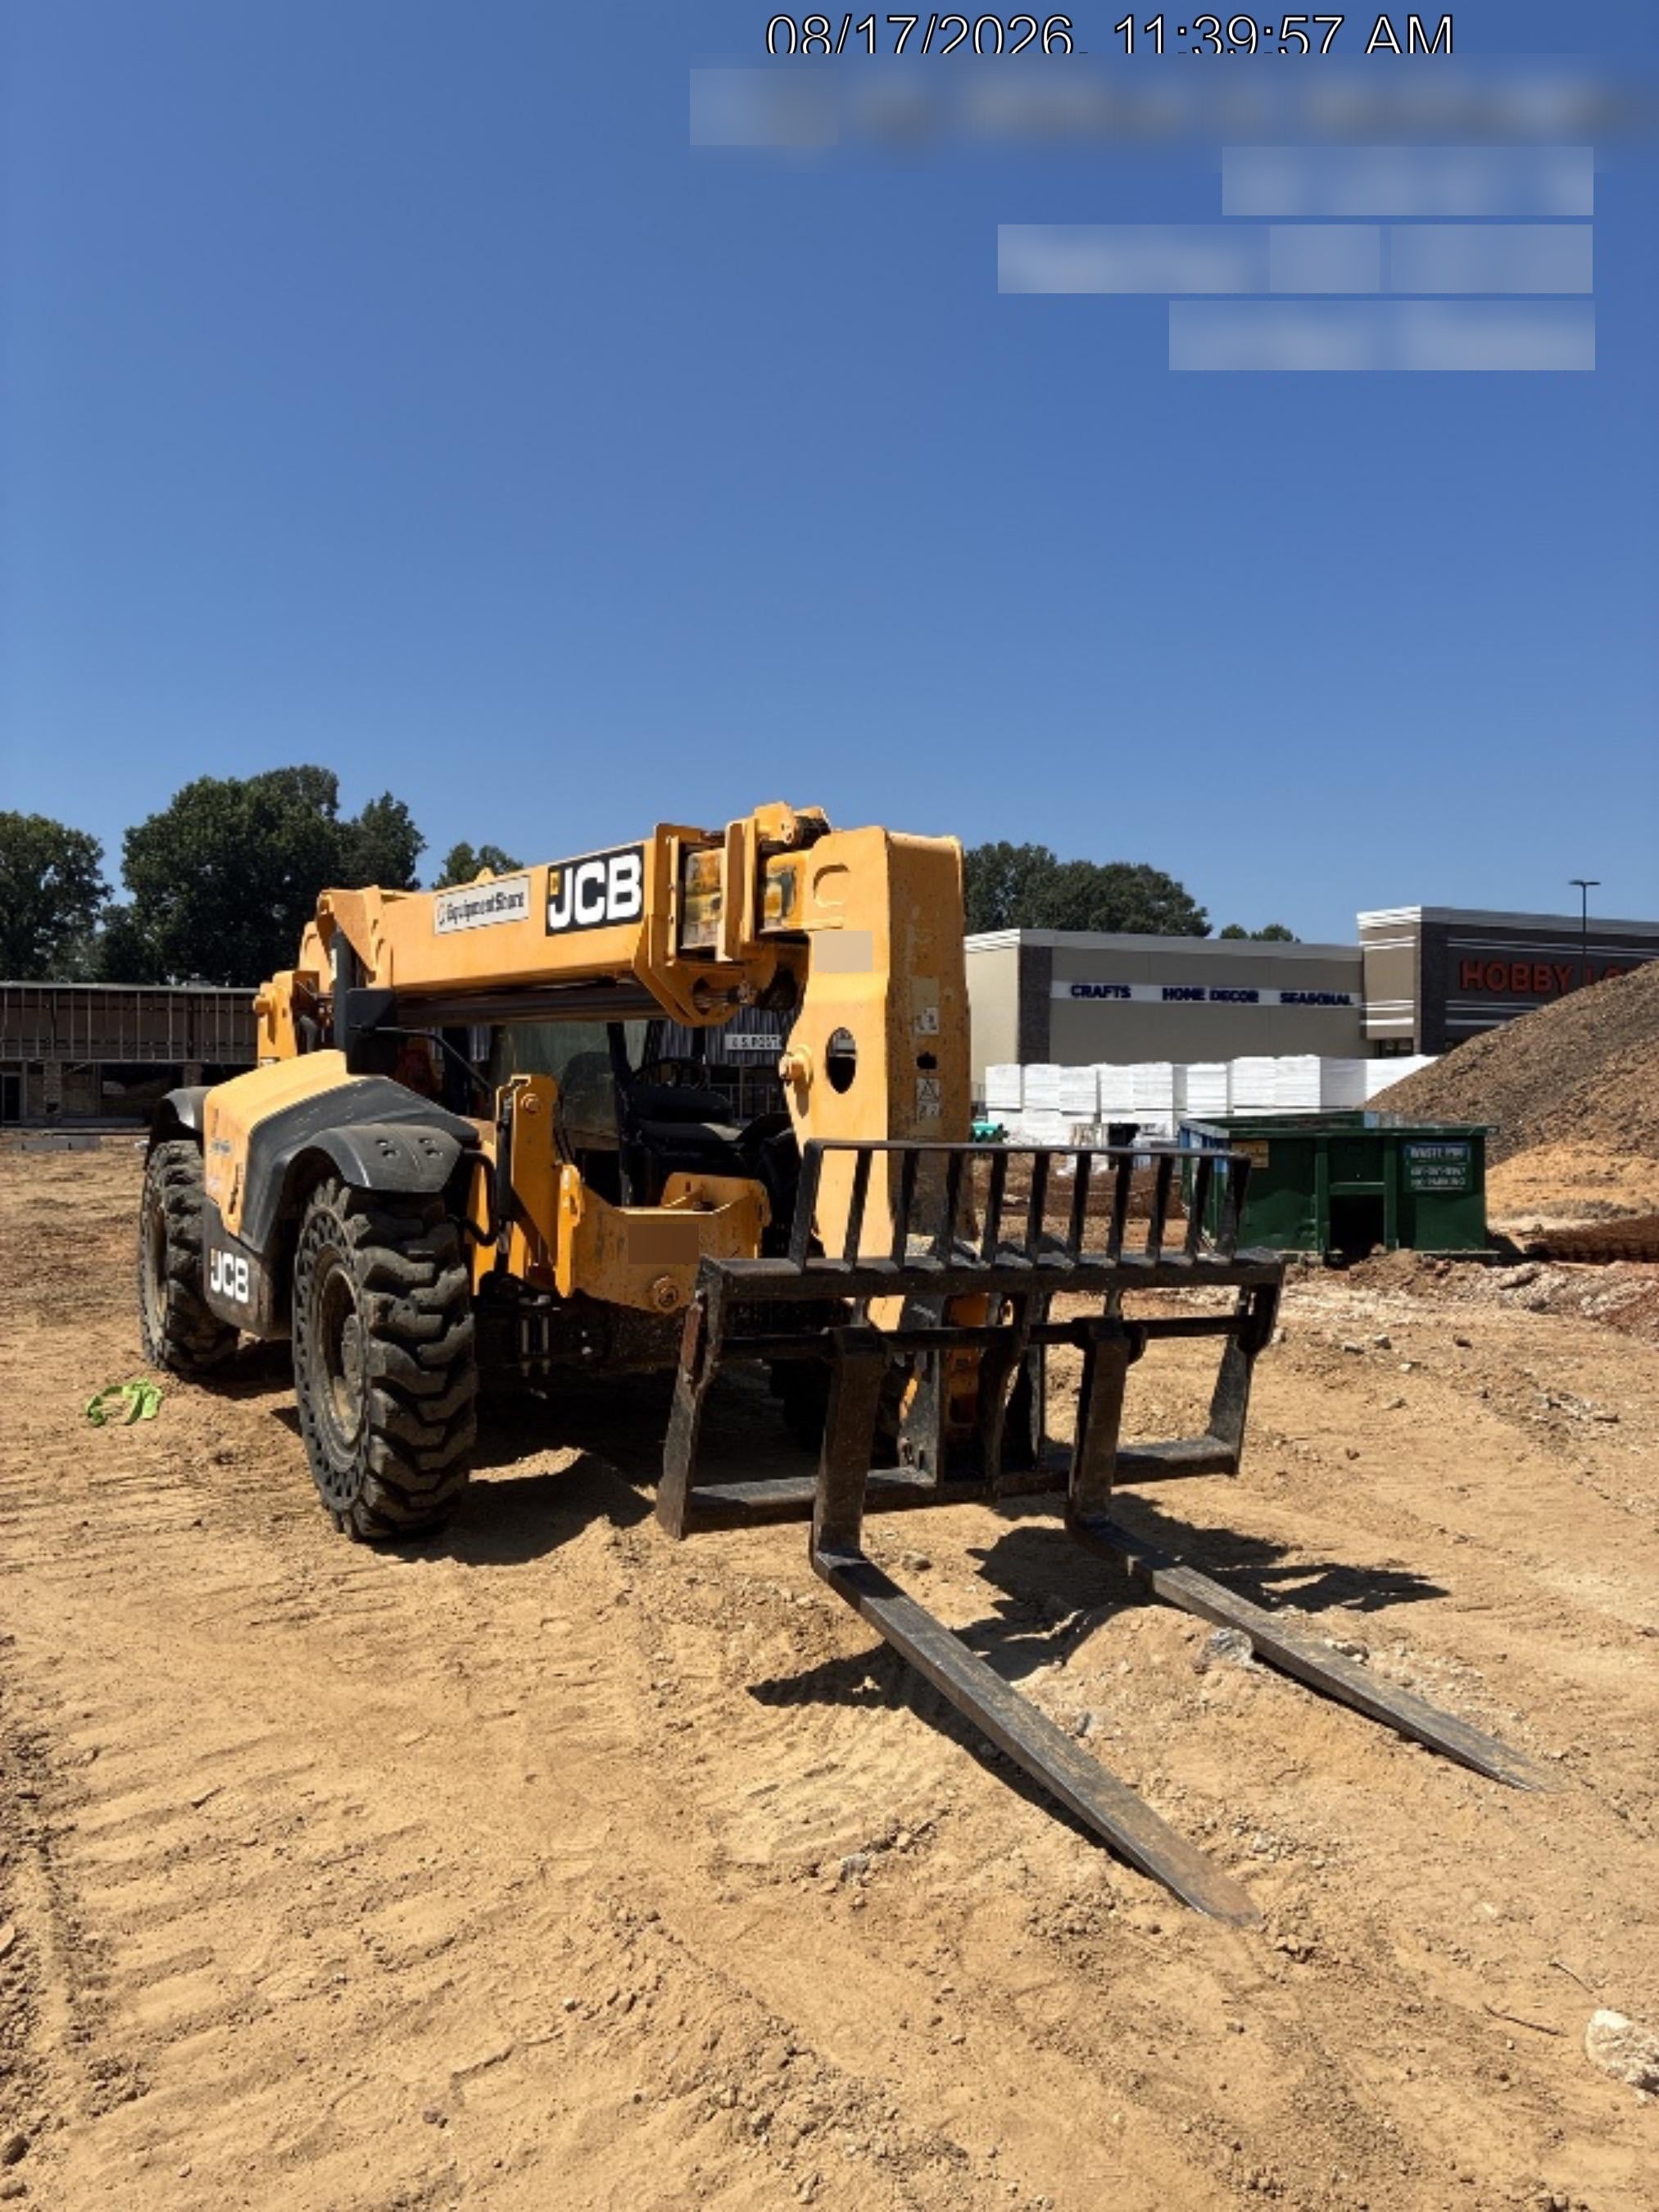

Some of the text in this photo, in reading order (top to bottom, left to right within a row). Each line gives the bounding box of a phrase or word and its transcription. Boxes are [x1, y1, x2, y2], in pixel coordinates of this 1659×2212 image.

[549, 854, 642, 929] JCB
[1460, 961, 1573, 994] HOBBY
[1072, 985, 1131, 999] CRAFTS
[1163, 987, 1259, 1003] HOME DECOR
[1281, 991, 1353, 1005] SEASONAL
[210, 1249, 249, 1303] JCB
